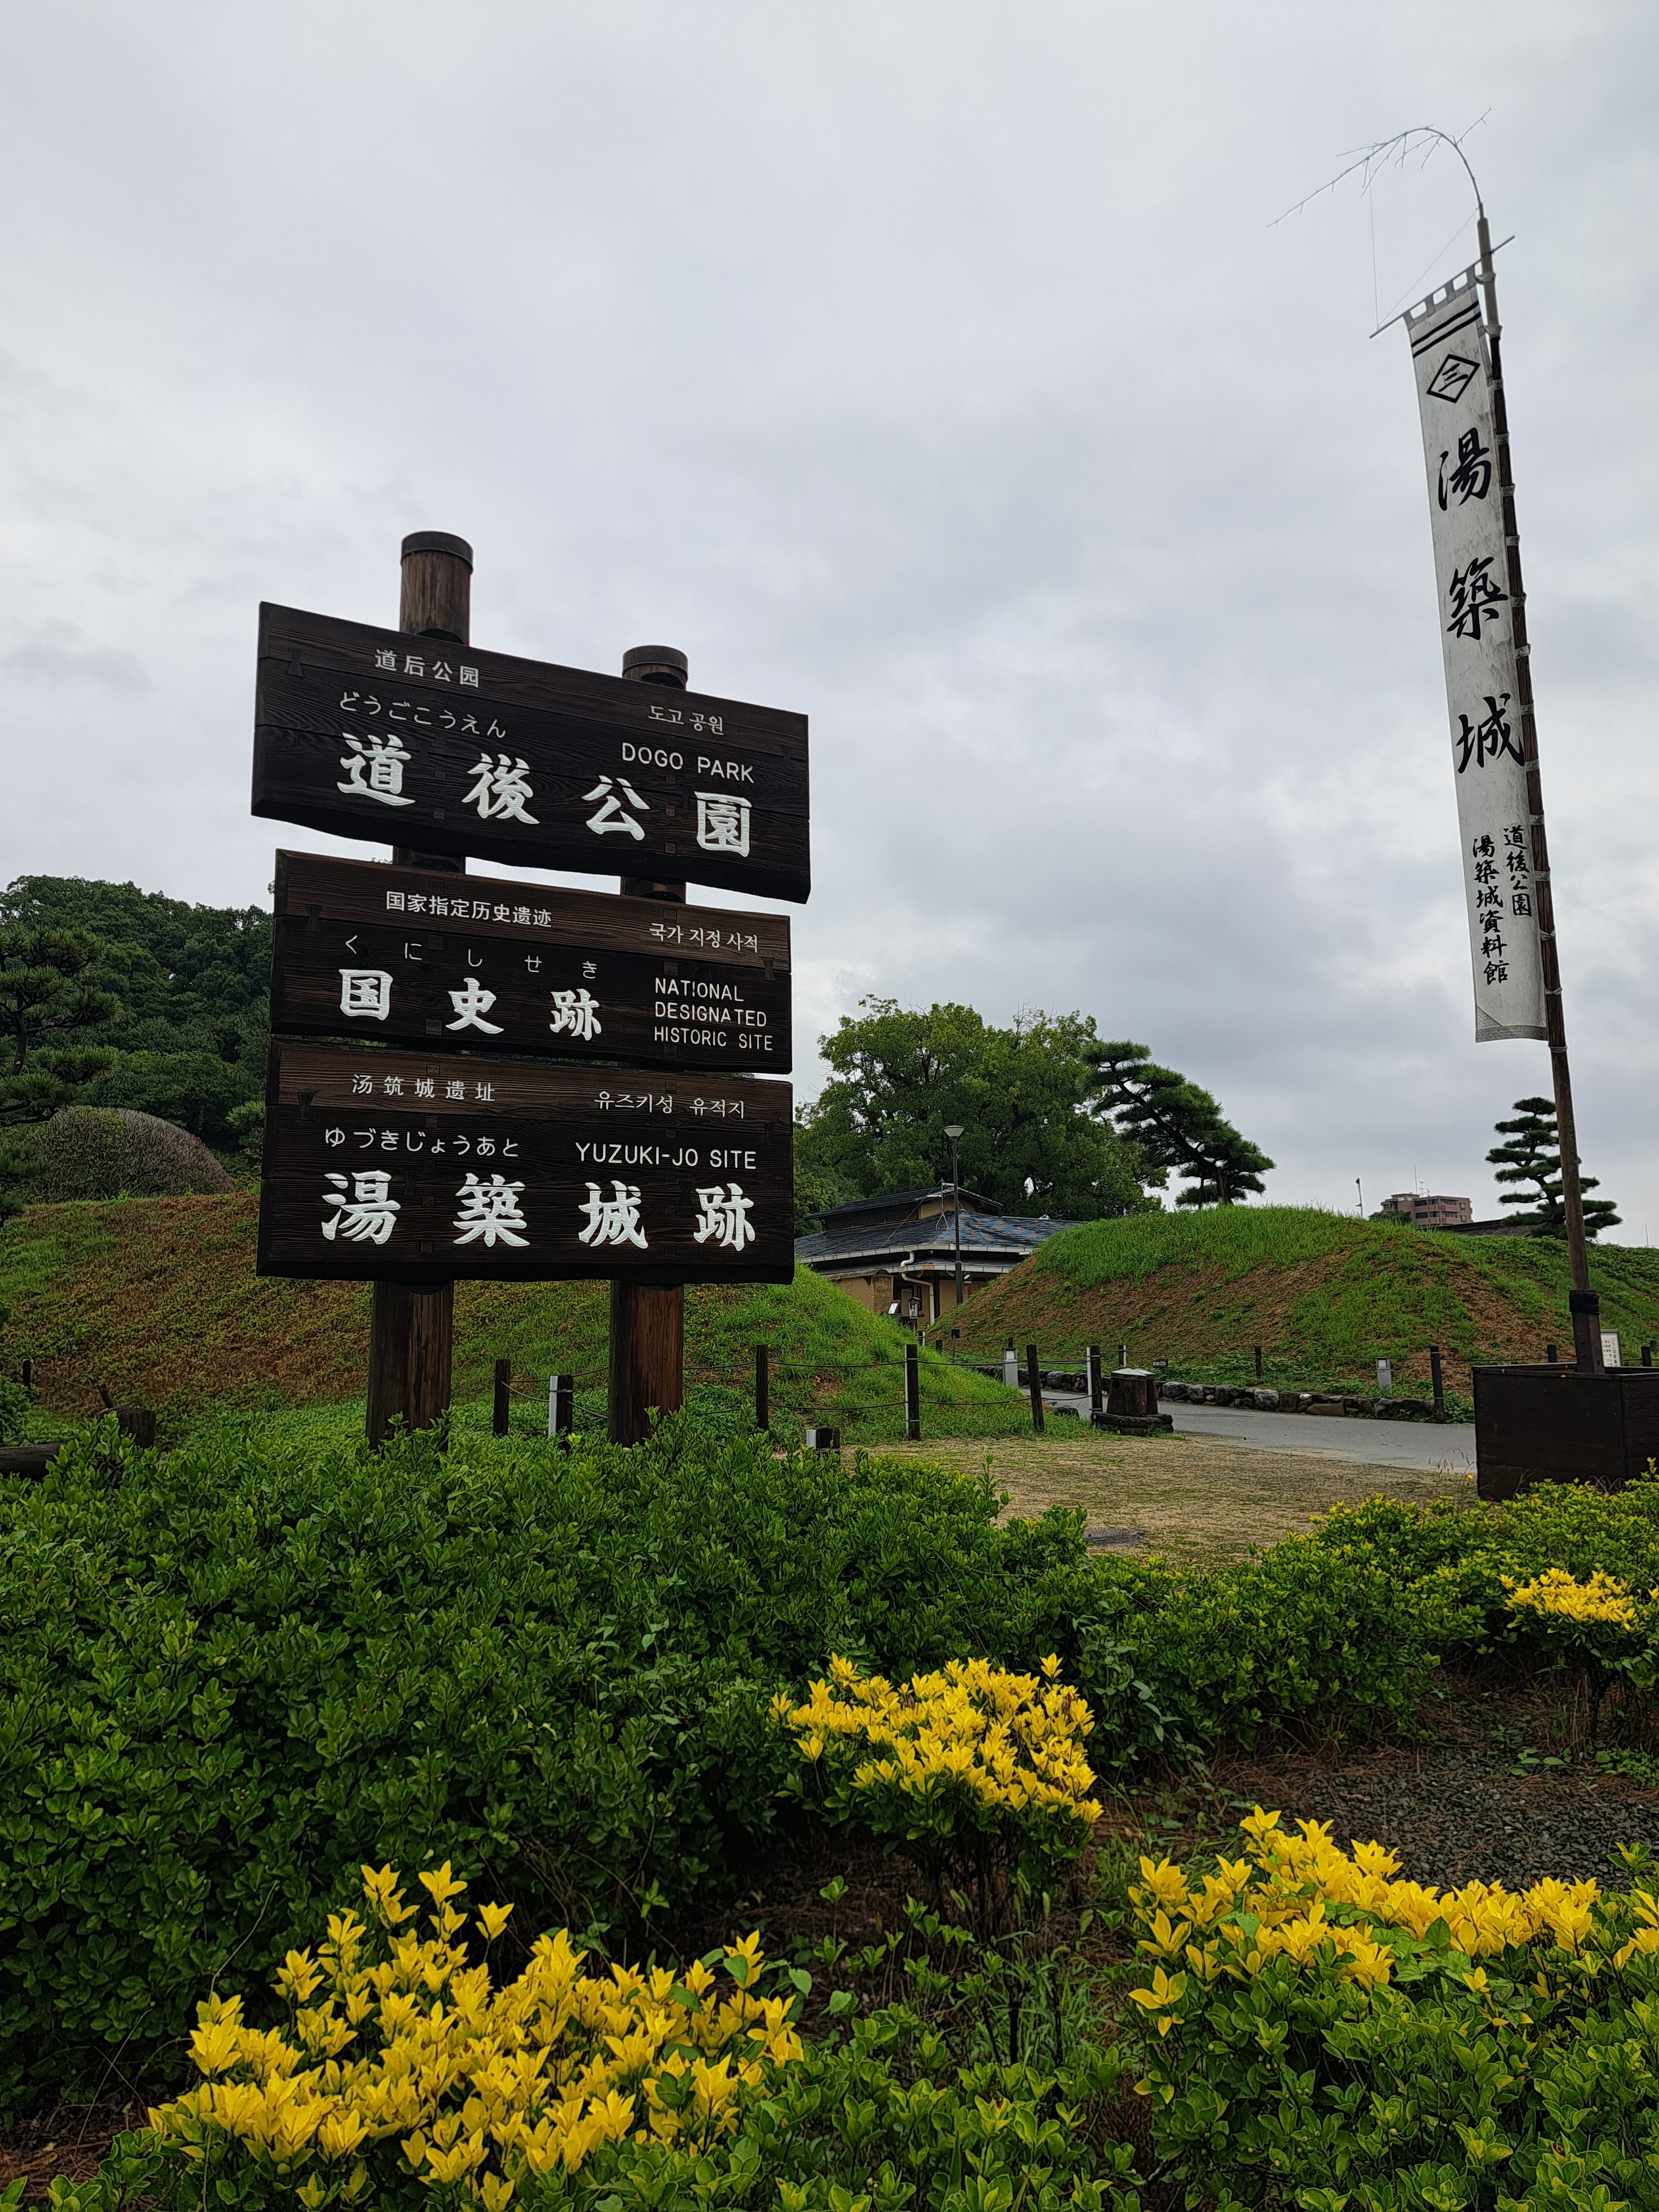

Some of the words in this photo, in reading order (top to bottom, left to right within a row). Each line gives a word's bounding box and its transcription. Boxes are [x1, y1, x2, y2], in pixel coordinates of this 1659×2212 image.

[1438, 427, 1526, 774] 湯築城
[375, 649, 478, 688] 道后公园
[340, 692, 506, 738] どうごこうえん
[648, 706, 684, 724] 도고
[689, 713, 724, 735] 공원
[622, 742, 683, 770] DOGO
[698, 756, 754, 784] PARK
[337, 732, 752, 857] 道後公園
[1503, 824, 1532, 918] 道後公園
[386, 891, 552, 928] 国家指定历史遗迹
[1472, 834, 1510, 985] 湯築城資料館
[345, 935, 597, 979] くにしせき
[649, 923, 684, 944] 국가
[689, 928, 720, 948] 지정
[726, 932, 757, 953] 사적
[338, 969, 602, 1041] 国史跡
[655, 977, 744, 1002] NATIONAL
[655, 1001, 766, 1027] DESIGNATED
[654, 1026, 727, 1047] HISTORIC
[739, 1033, 773, 1051] SITE
[352, 1074, 496, 1101] 汤筑城遗址
[594, 1091, 672, 1114] 유즈키성
[689, 1097, 744, 1119] 유적지
[325, 1127, 518, 1157] ゆづきじょうあと
[575, 1142, 698, 1166] YUZUKI-JO
[709, 1149, 756, 1169] SITE
[321, 1170, 755, 1251] 湯築城跡
